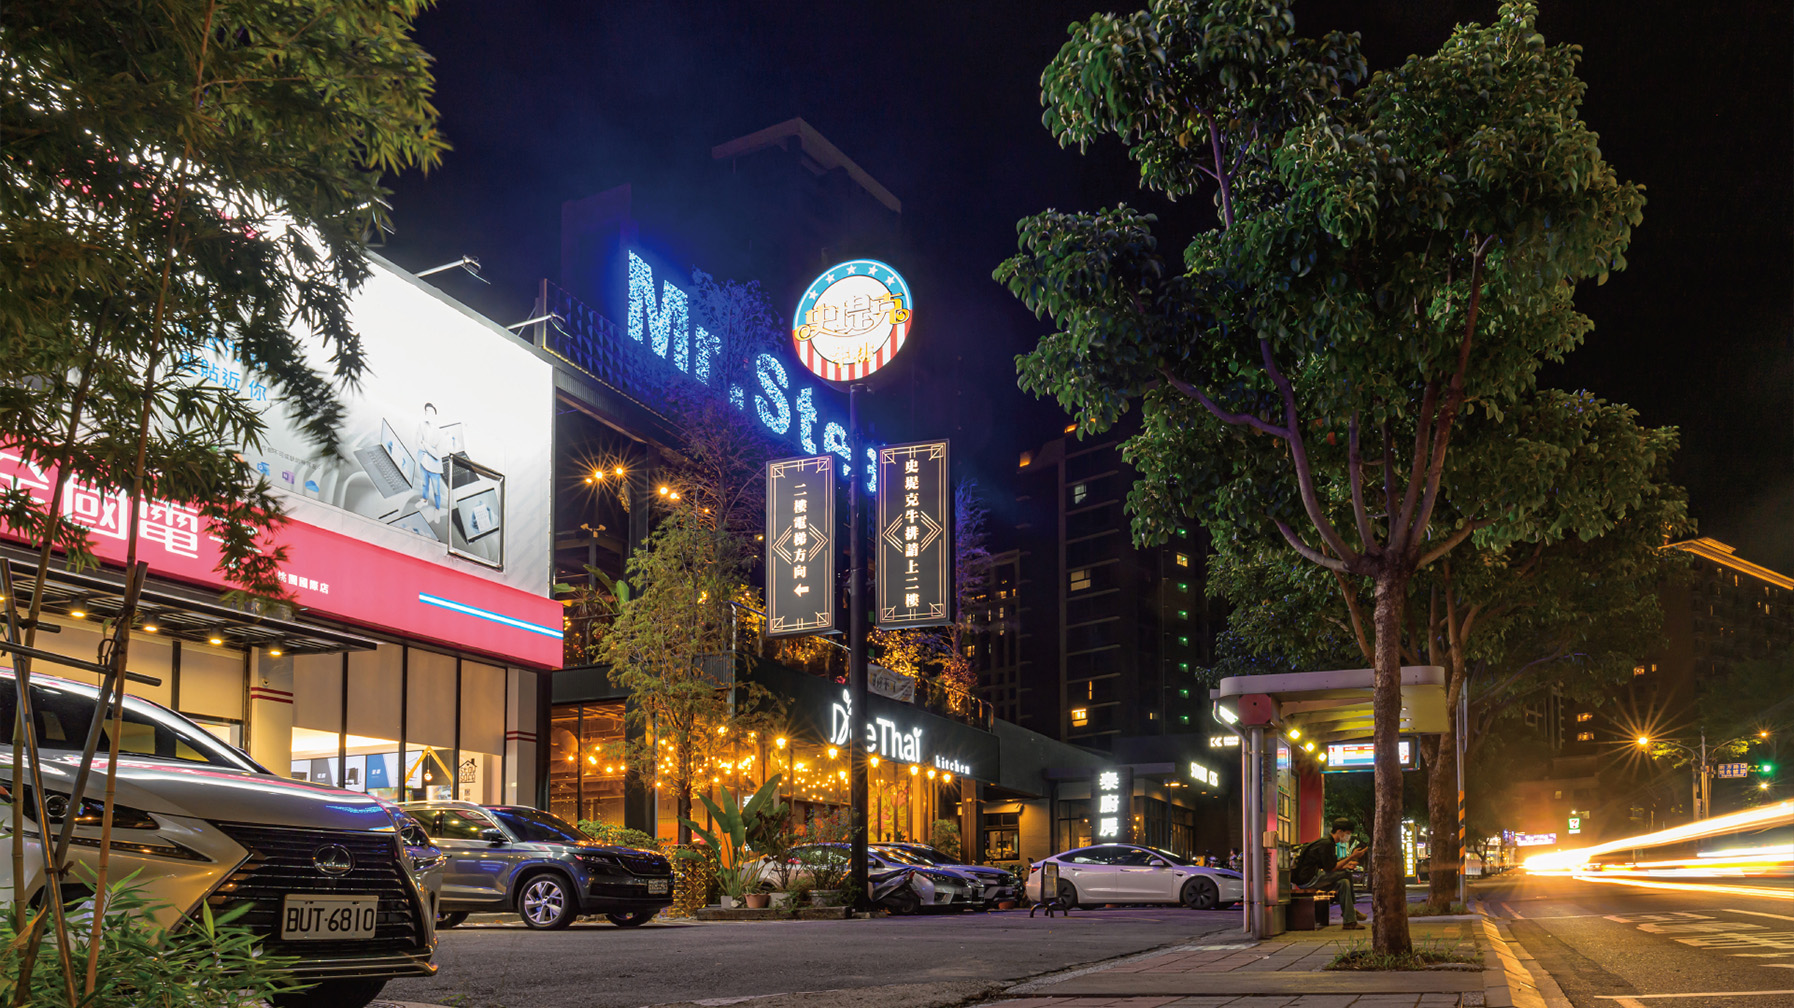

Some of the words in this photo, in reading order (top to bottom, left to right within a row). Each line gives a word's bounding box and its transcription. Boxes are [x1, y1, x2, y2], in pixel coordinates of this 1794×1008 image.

[793, 482, 808, 579] 二樓電梯方向
[904, 458, 920, 608] 史堤克牛排請上二樓
[935, 755, 971, 775] kitchen
